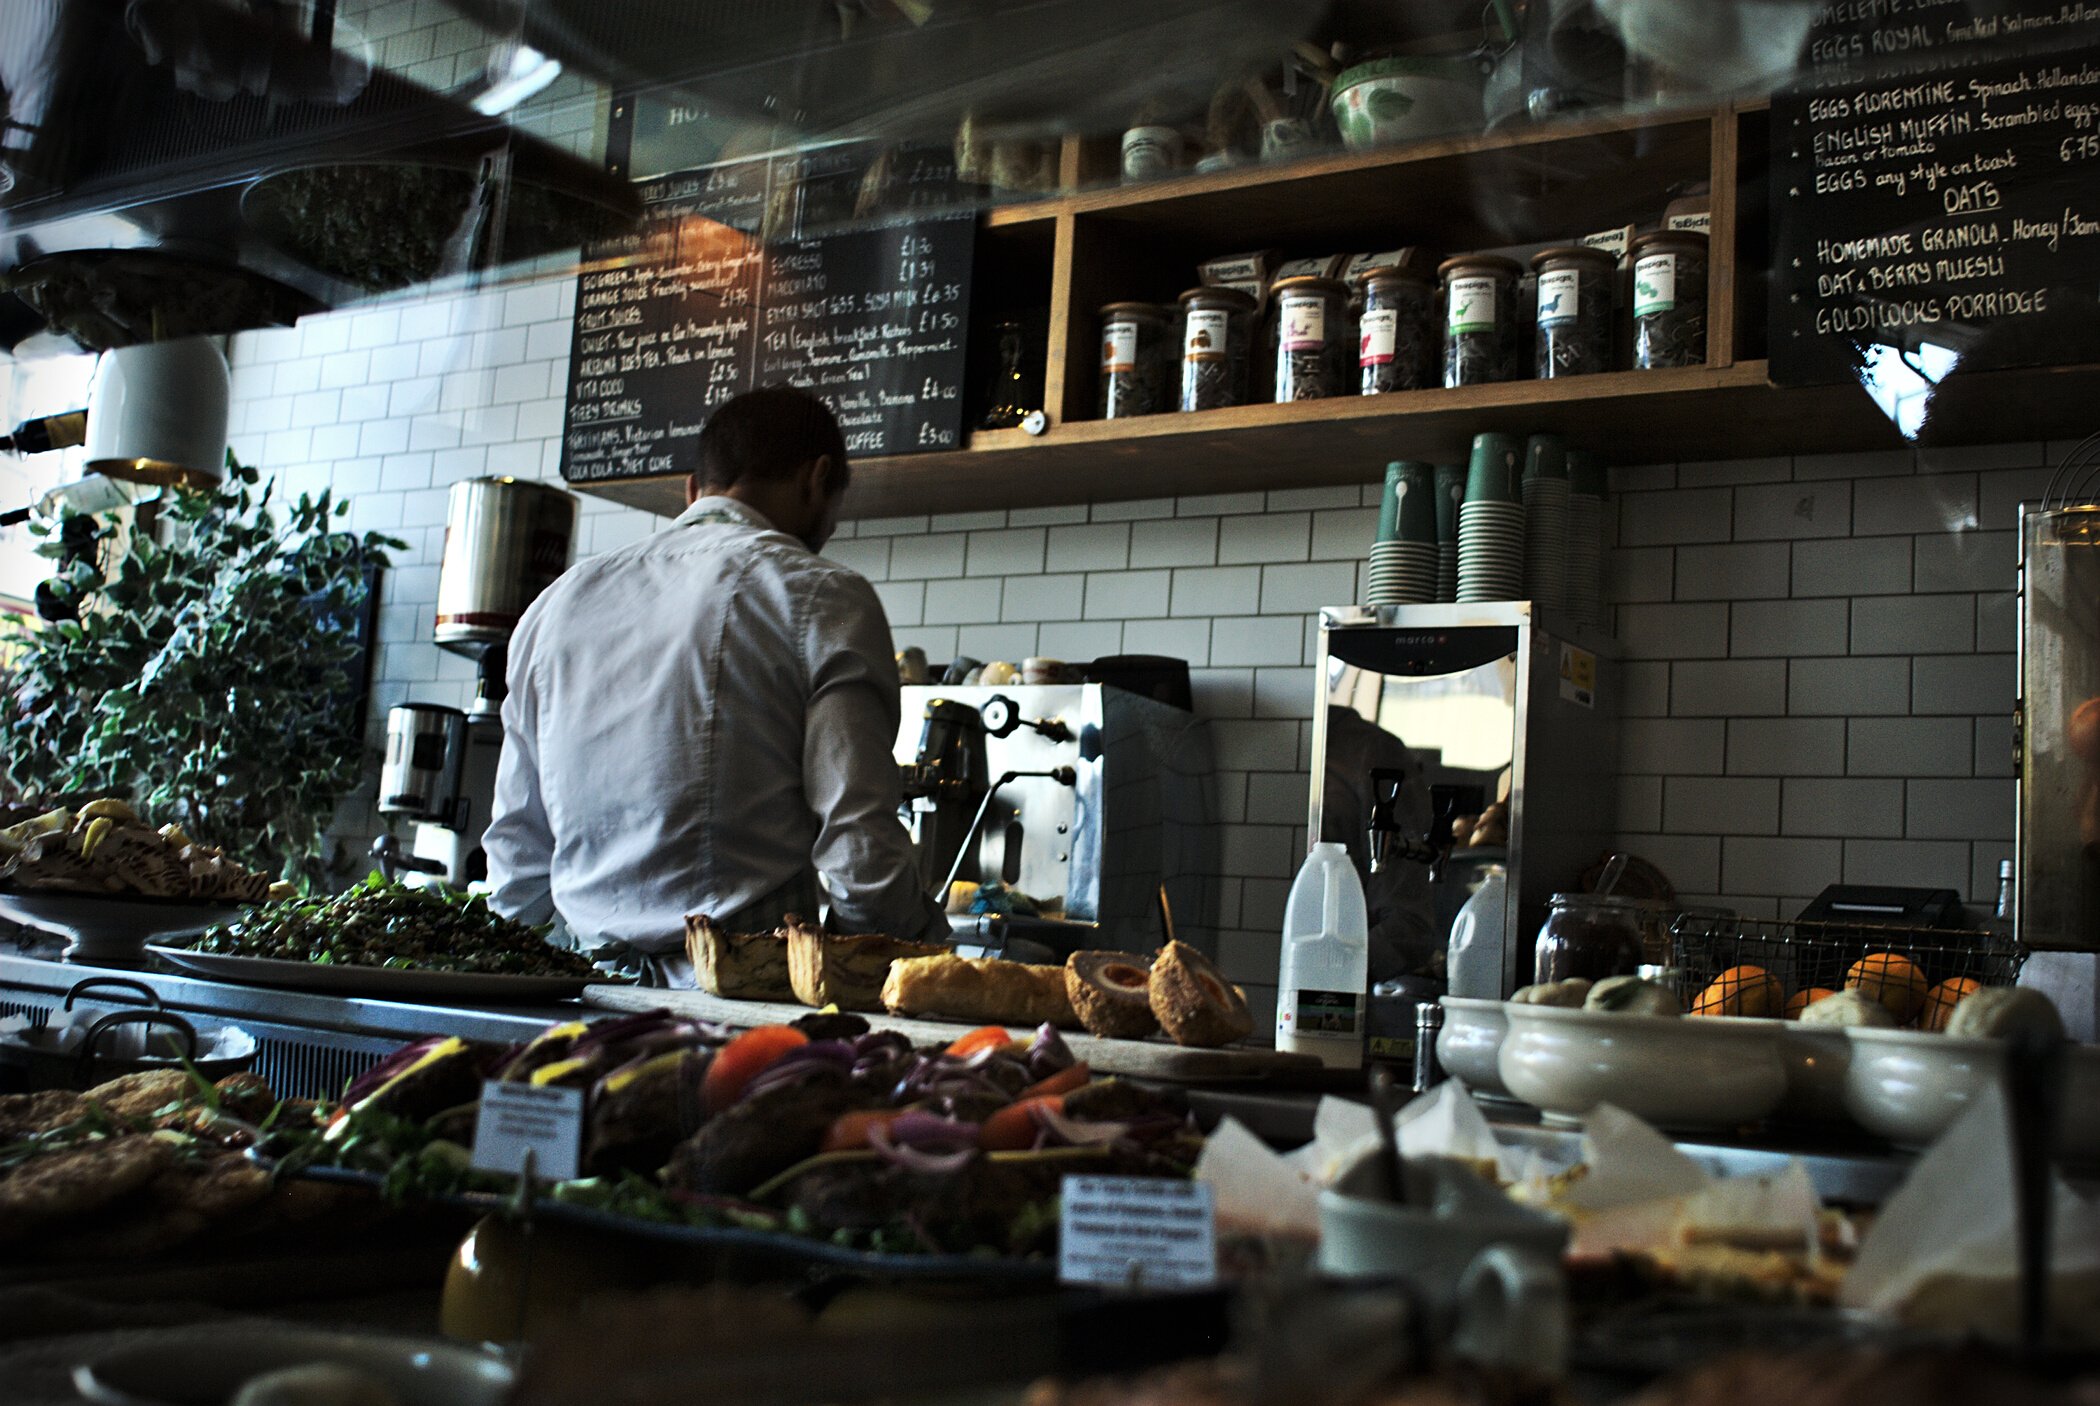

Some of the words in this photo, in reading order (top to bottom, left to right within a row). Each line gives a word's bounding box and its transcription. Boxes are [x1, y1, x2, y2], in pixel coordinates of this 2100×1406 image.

[1812, 33, 1864, 63] EGGS
[1872, 24, 1933, 53] ROYAL
[1809, 98, 1850, 123] EGGS
[1853, 80, 1955, 115] FLORENTINE
[1969, 71, 2033, 109] Spinach
[669, 106, 710, 126] HO
[1813, 122, 1894, 154] ENGLISH
[1900, 108, 1971, 141] MUFFIN
[1980, 99, 2060, 130] Scrambled
[2064, 102, 2100, 130] eggs
[1815, 153, 1859, 167] bacon
[1862, 149, 1878, 162] or
[1880, 139, 1936, 160] tomato
[1815, 169, 1867, 194] EGGS
[1875, 170, 1906, 196] any
[1909, 161, 1949, 192] style
[1951, 161, 1973, 176] on
[1974, 147, 2018, 173] toast
[1943, 180, 2000, 213] OATS
[1817, 234, 1914, 264] HOMEMADE
[1922, 222, 2000, 251] GRANOLA
[2013, 218, 2058, 253] Honey
[1818, 268, 1856, 298] OAT
[1867, 262, 1932, 290] BERRY
[1815, 298, 1941, 335] GOLDILOCKS
[1945, 288, 2048, 321] PORRIDGE
[763, 331, 787, 352] TEA
[846, 431, 884, 451] COFFEE
[1395, 636, 1436, 646] marco
